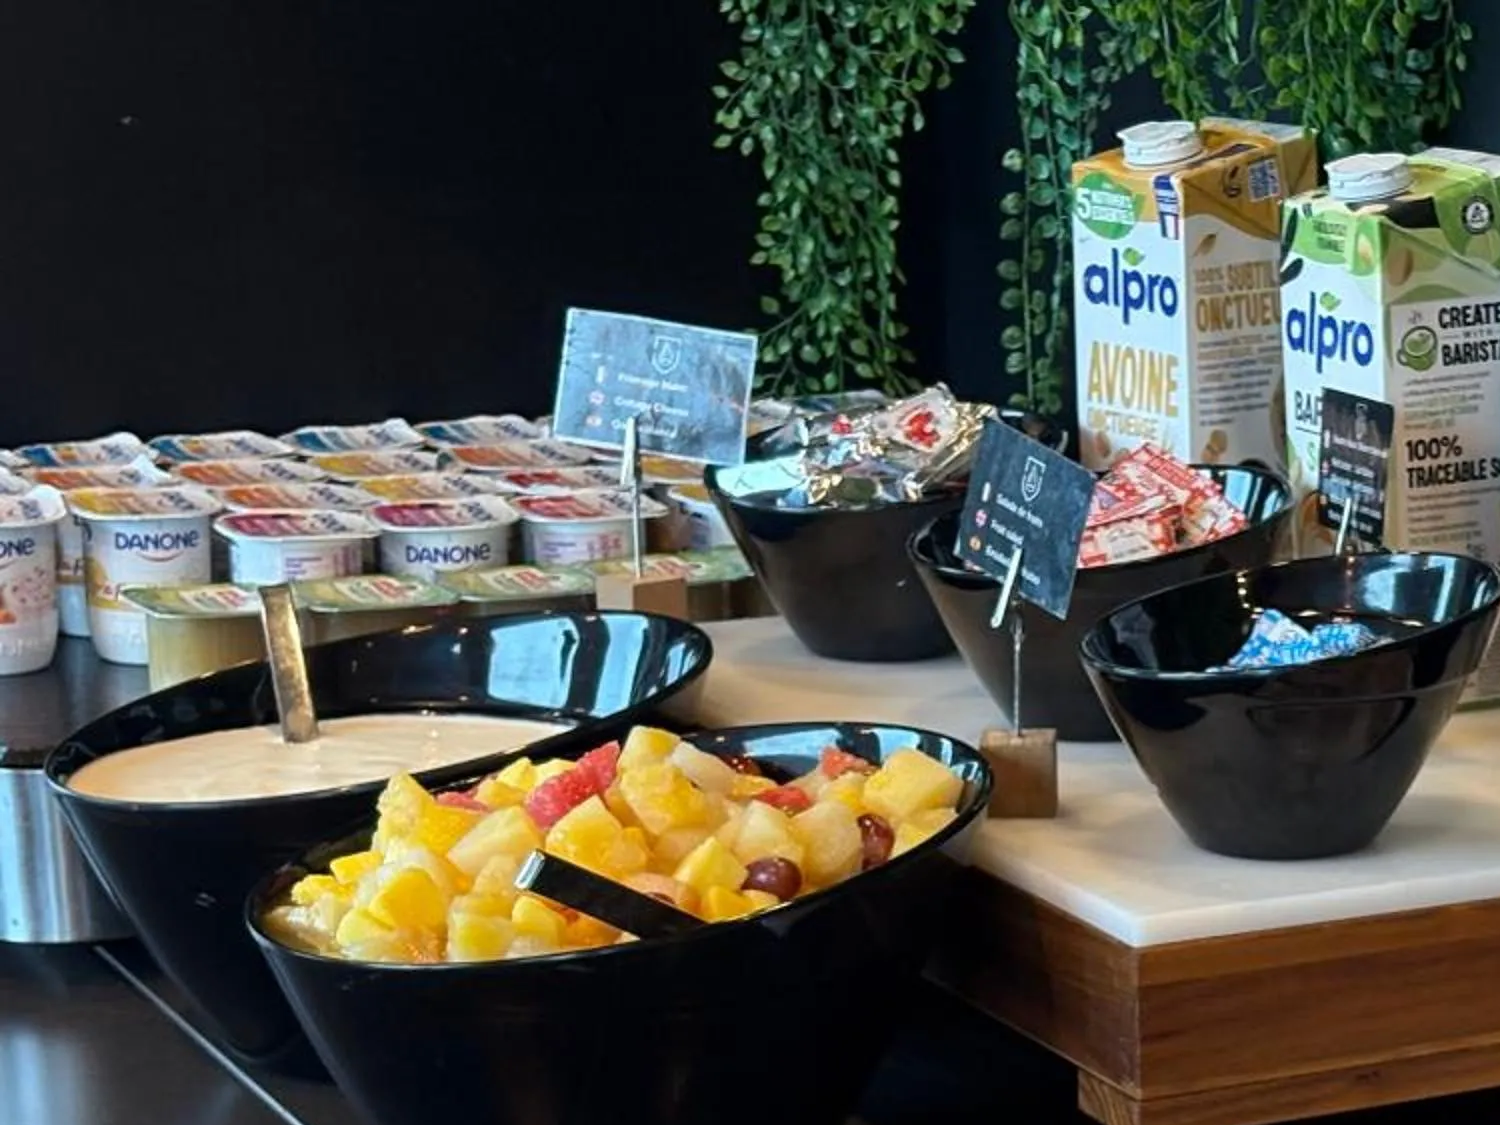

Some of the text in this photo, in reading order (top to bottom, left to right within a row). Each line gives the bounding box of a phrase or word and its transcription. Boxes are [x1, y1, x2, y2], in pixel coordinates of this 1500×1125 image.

[1083, 247, 1178, 325] alpro
[1286, 292, 1374, 373] alpro
[1087, 340, 1179, 418] AVOINE
[1404, 434, 1463, 463] 100%
[1406, 457, 1487, 489] TRACEABLE
[115, 529, 199, 551] DANONE
[405, 542, 491, 564] DANONE
